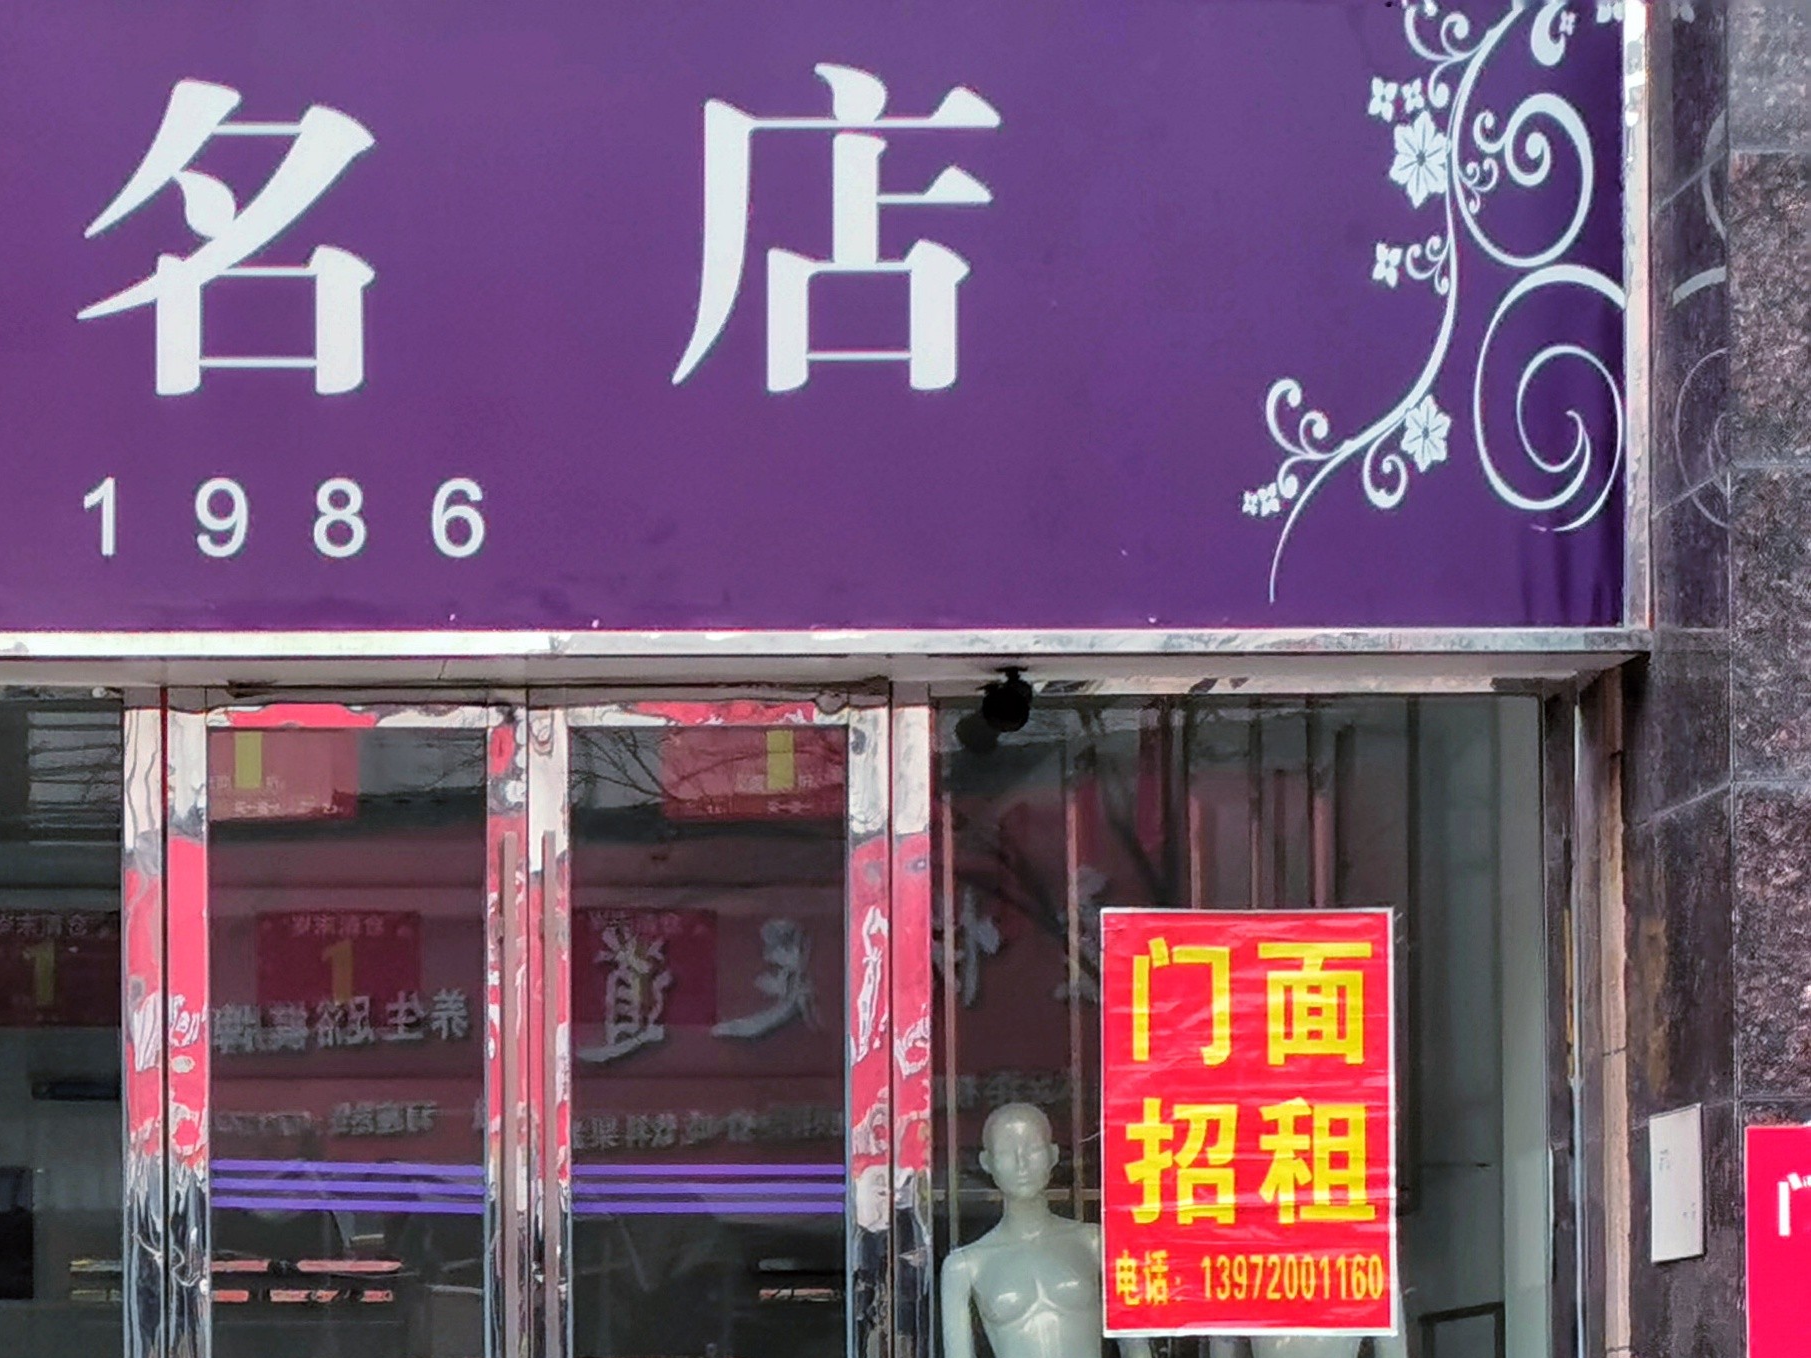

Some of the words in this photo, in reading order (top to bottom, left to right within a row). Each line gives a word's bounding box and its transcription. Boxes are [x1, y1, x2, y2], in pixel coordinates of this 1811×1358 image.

[82, 477, 486, 559] 1986
[1132, 936, 1373, 1067] 门面
[1125, 1097, 1376, 1225] 招租
[1200, 1254, 1384, 1302] 13972001160
